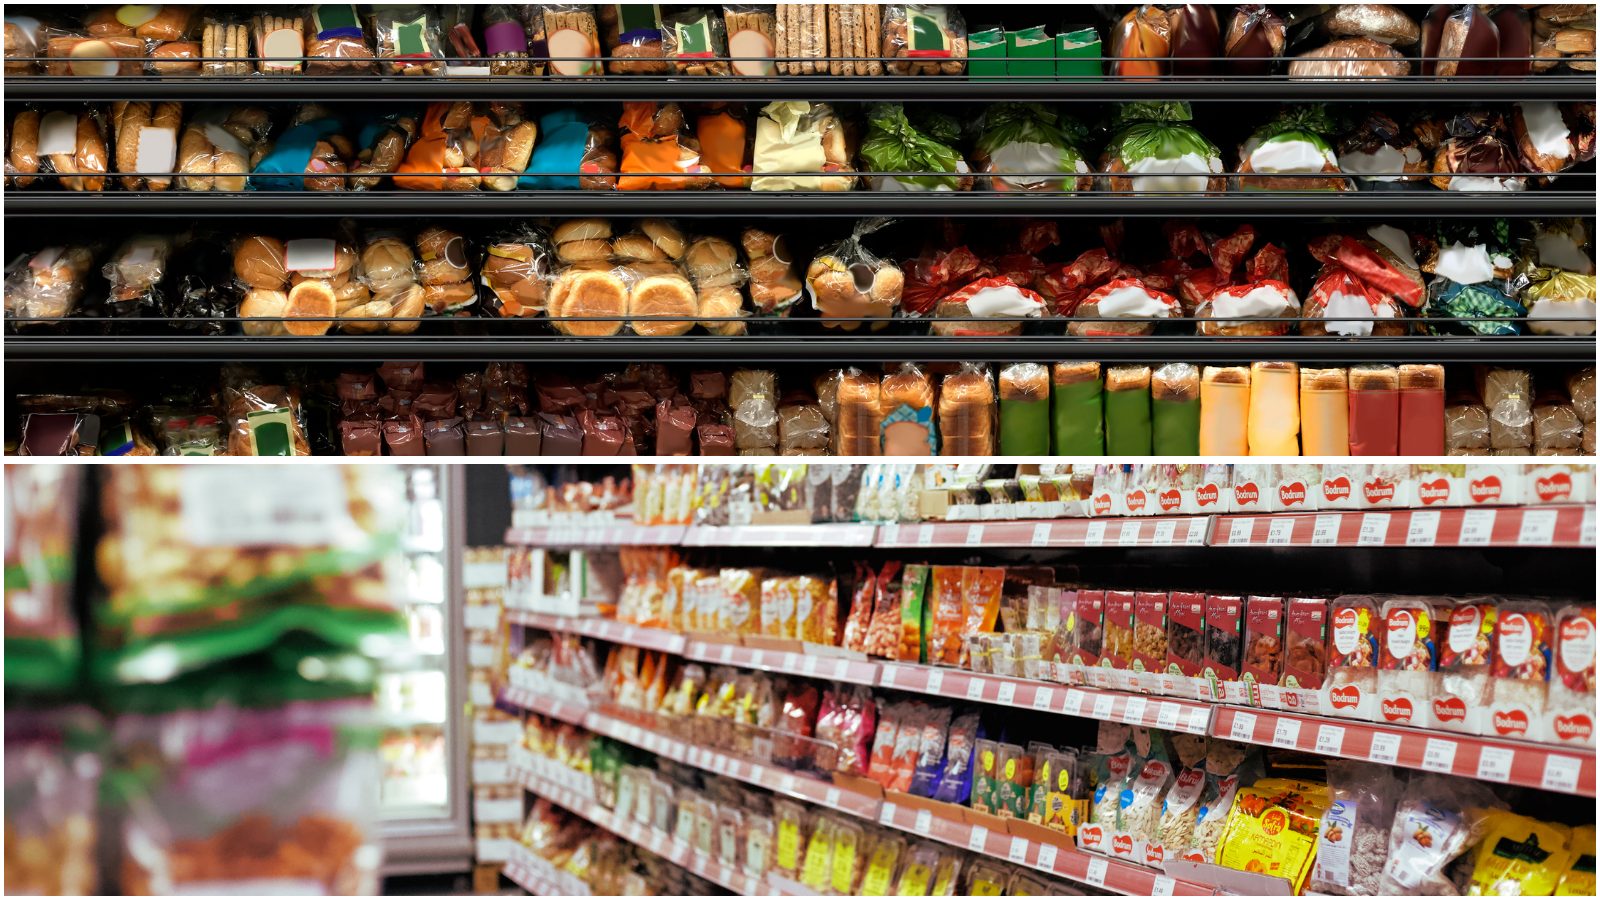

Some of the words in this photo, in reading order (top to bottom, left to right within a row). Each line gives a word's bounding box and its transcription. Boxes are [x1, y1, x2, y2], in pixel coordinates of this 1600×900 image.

[1325, 484, 1350, 495] Bodrum
[1365, 487, 1393, 497] Bodrum
[1421, 487, 1449, 498] Bodrum
[1472, 484, 1500, 496] Bodrum
[1538, 481, 1570, 493] Bodrum
[1197, 491, 1218, 501] Bodrum
[1235, 489, 1259, 499] Bodrum
[1281, 490, 1305, 500] Bodrum
[1160, 495, 1180, 505] Bodrum
[1332, 693, 1358, 704] Bodrum
[1383, 704, 1411, 716] Bodrum
[1435, 704, 1465, 716] Bodrum
[1495, 716, 1527, 729] Bodrum
[1557, 721, 1591, 734] Bodrum
